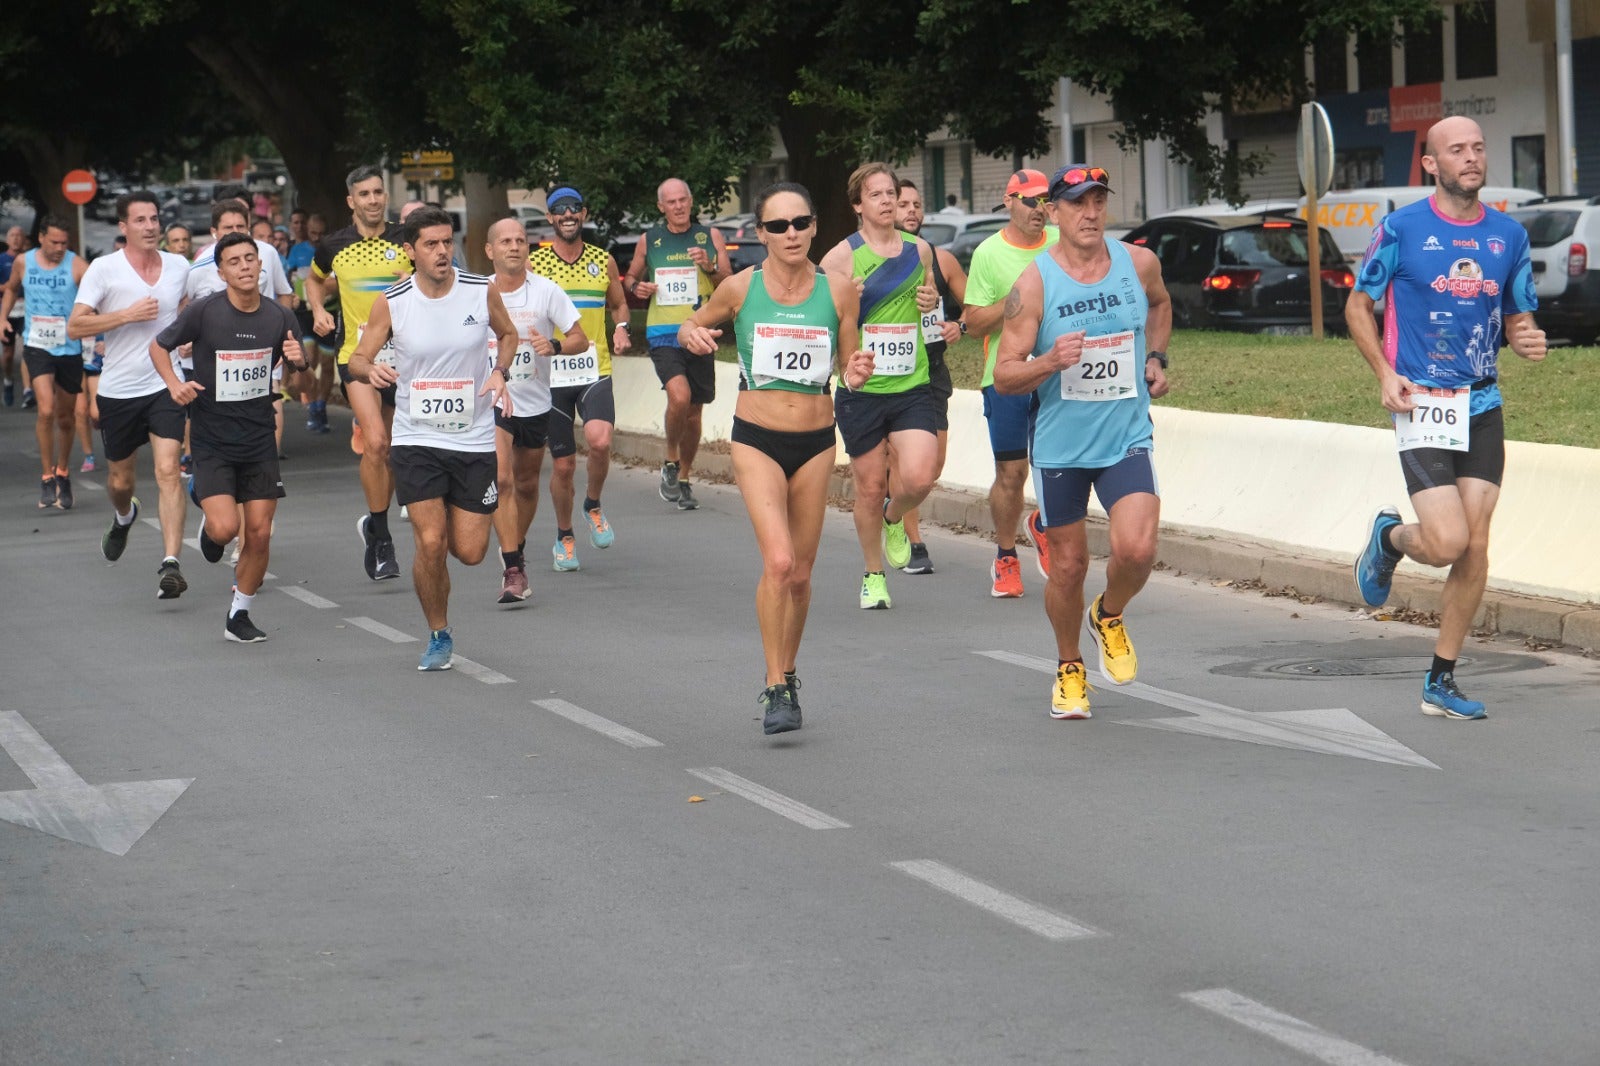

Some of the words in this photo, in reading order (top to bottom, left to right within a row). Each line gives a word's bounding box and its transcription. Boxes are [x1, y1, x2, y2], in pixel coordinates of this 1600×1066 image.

[29, 275, 67, 289] nerja
[666, 282, 687, 293] 189
[1057, 292, 1121, 319] nerja
[1071, 312, 1117, 329] ATLETISMO
[38, 328, 57, 339] 244
[868, 341, 914, 356] 11959
[552, 356, 595, 371] 11680
[773, 351, 812, 371] 120
[222, 364, 268, 382] 11688
[1081, 359, 1119, 380] 220
[421, 398, 465, 414] 3703
[1408, 405, 1458, 425] 1706
